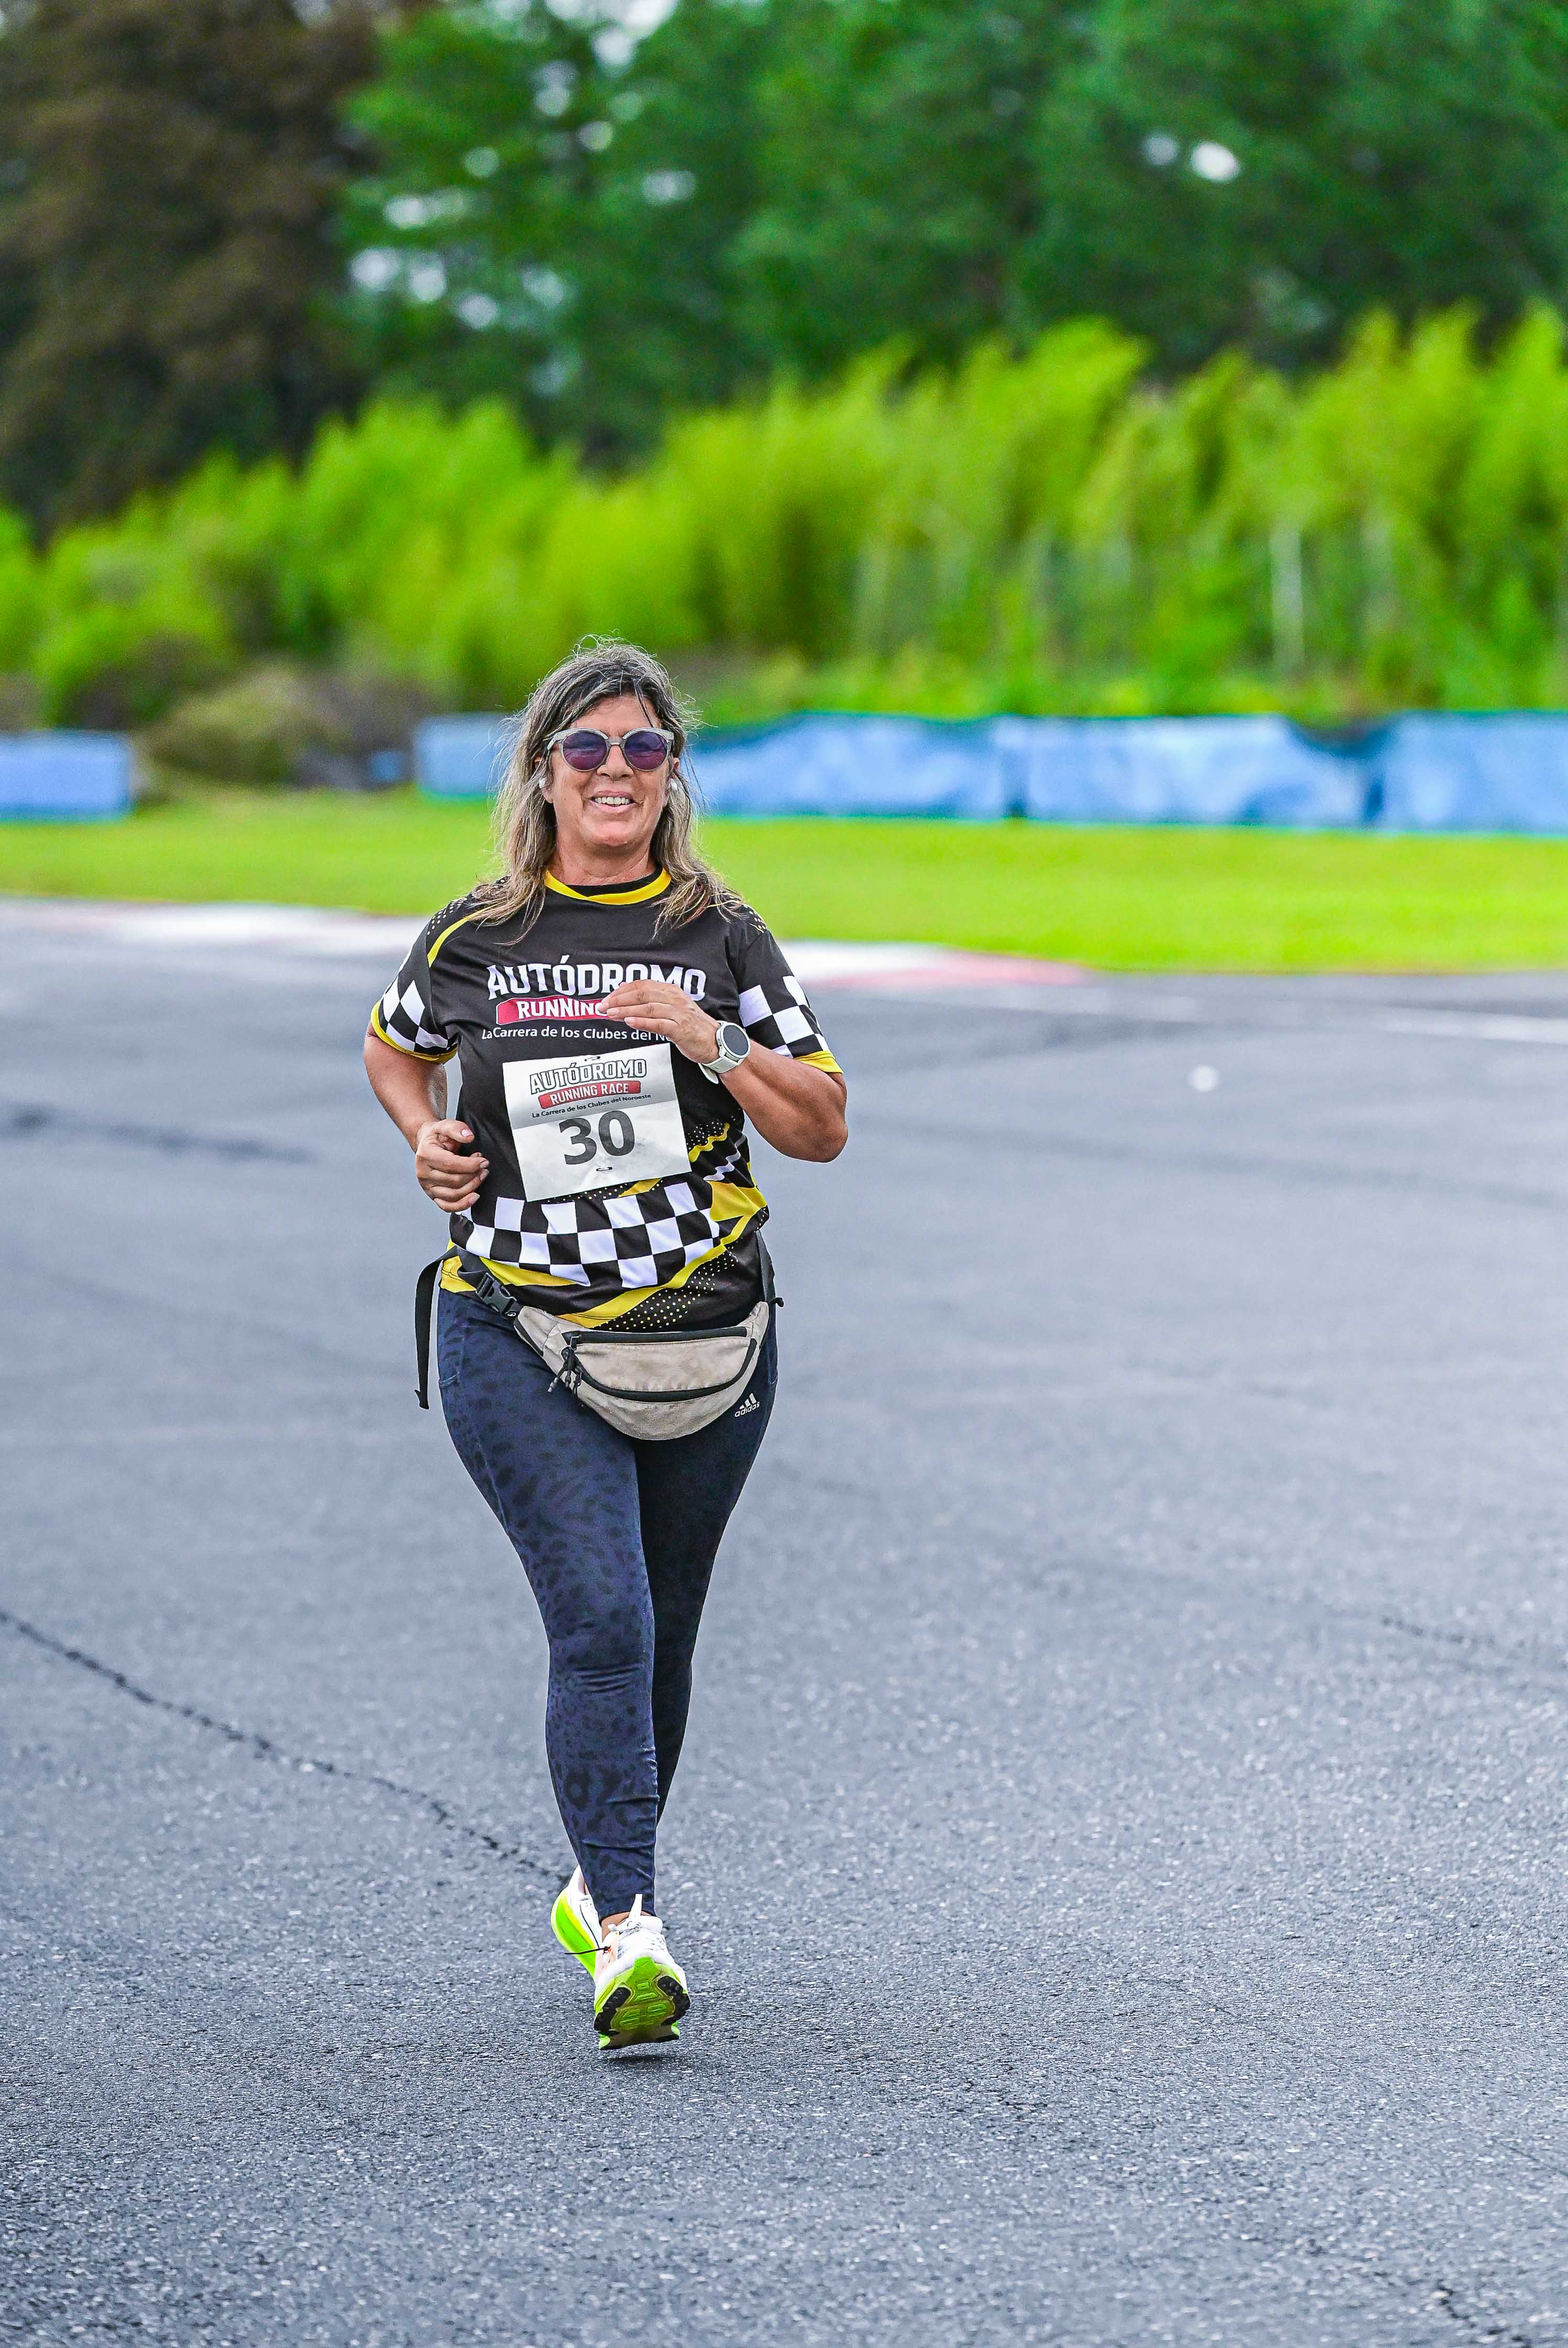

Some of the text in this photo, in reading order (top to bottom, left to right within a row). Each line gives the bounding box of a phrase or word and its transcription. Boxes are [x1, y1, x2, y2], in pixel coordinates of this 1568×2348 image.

[482, 1029, 492, 1039] La
[493, 1027, 538, 1038] Carrera
[541, 1026, 558, 1037] de
[561, 1027, 579, 1038] los
[583, 1029, 628, 1039] Clubes
[631, 1029, 651, 1040] del
[529, 1059, 647, 1095] AUTÓDROMO
[550, 1082, 629, 1105] RUNNING RACE
[541, 1108, 565, 1116] Carrera
[588, 1100, 609, 1108] Clubes
[559, 1110, 635, 1165] 30
[734, 1402, 760, 1417] adidas
